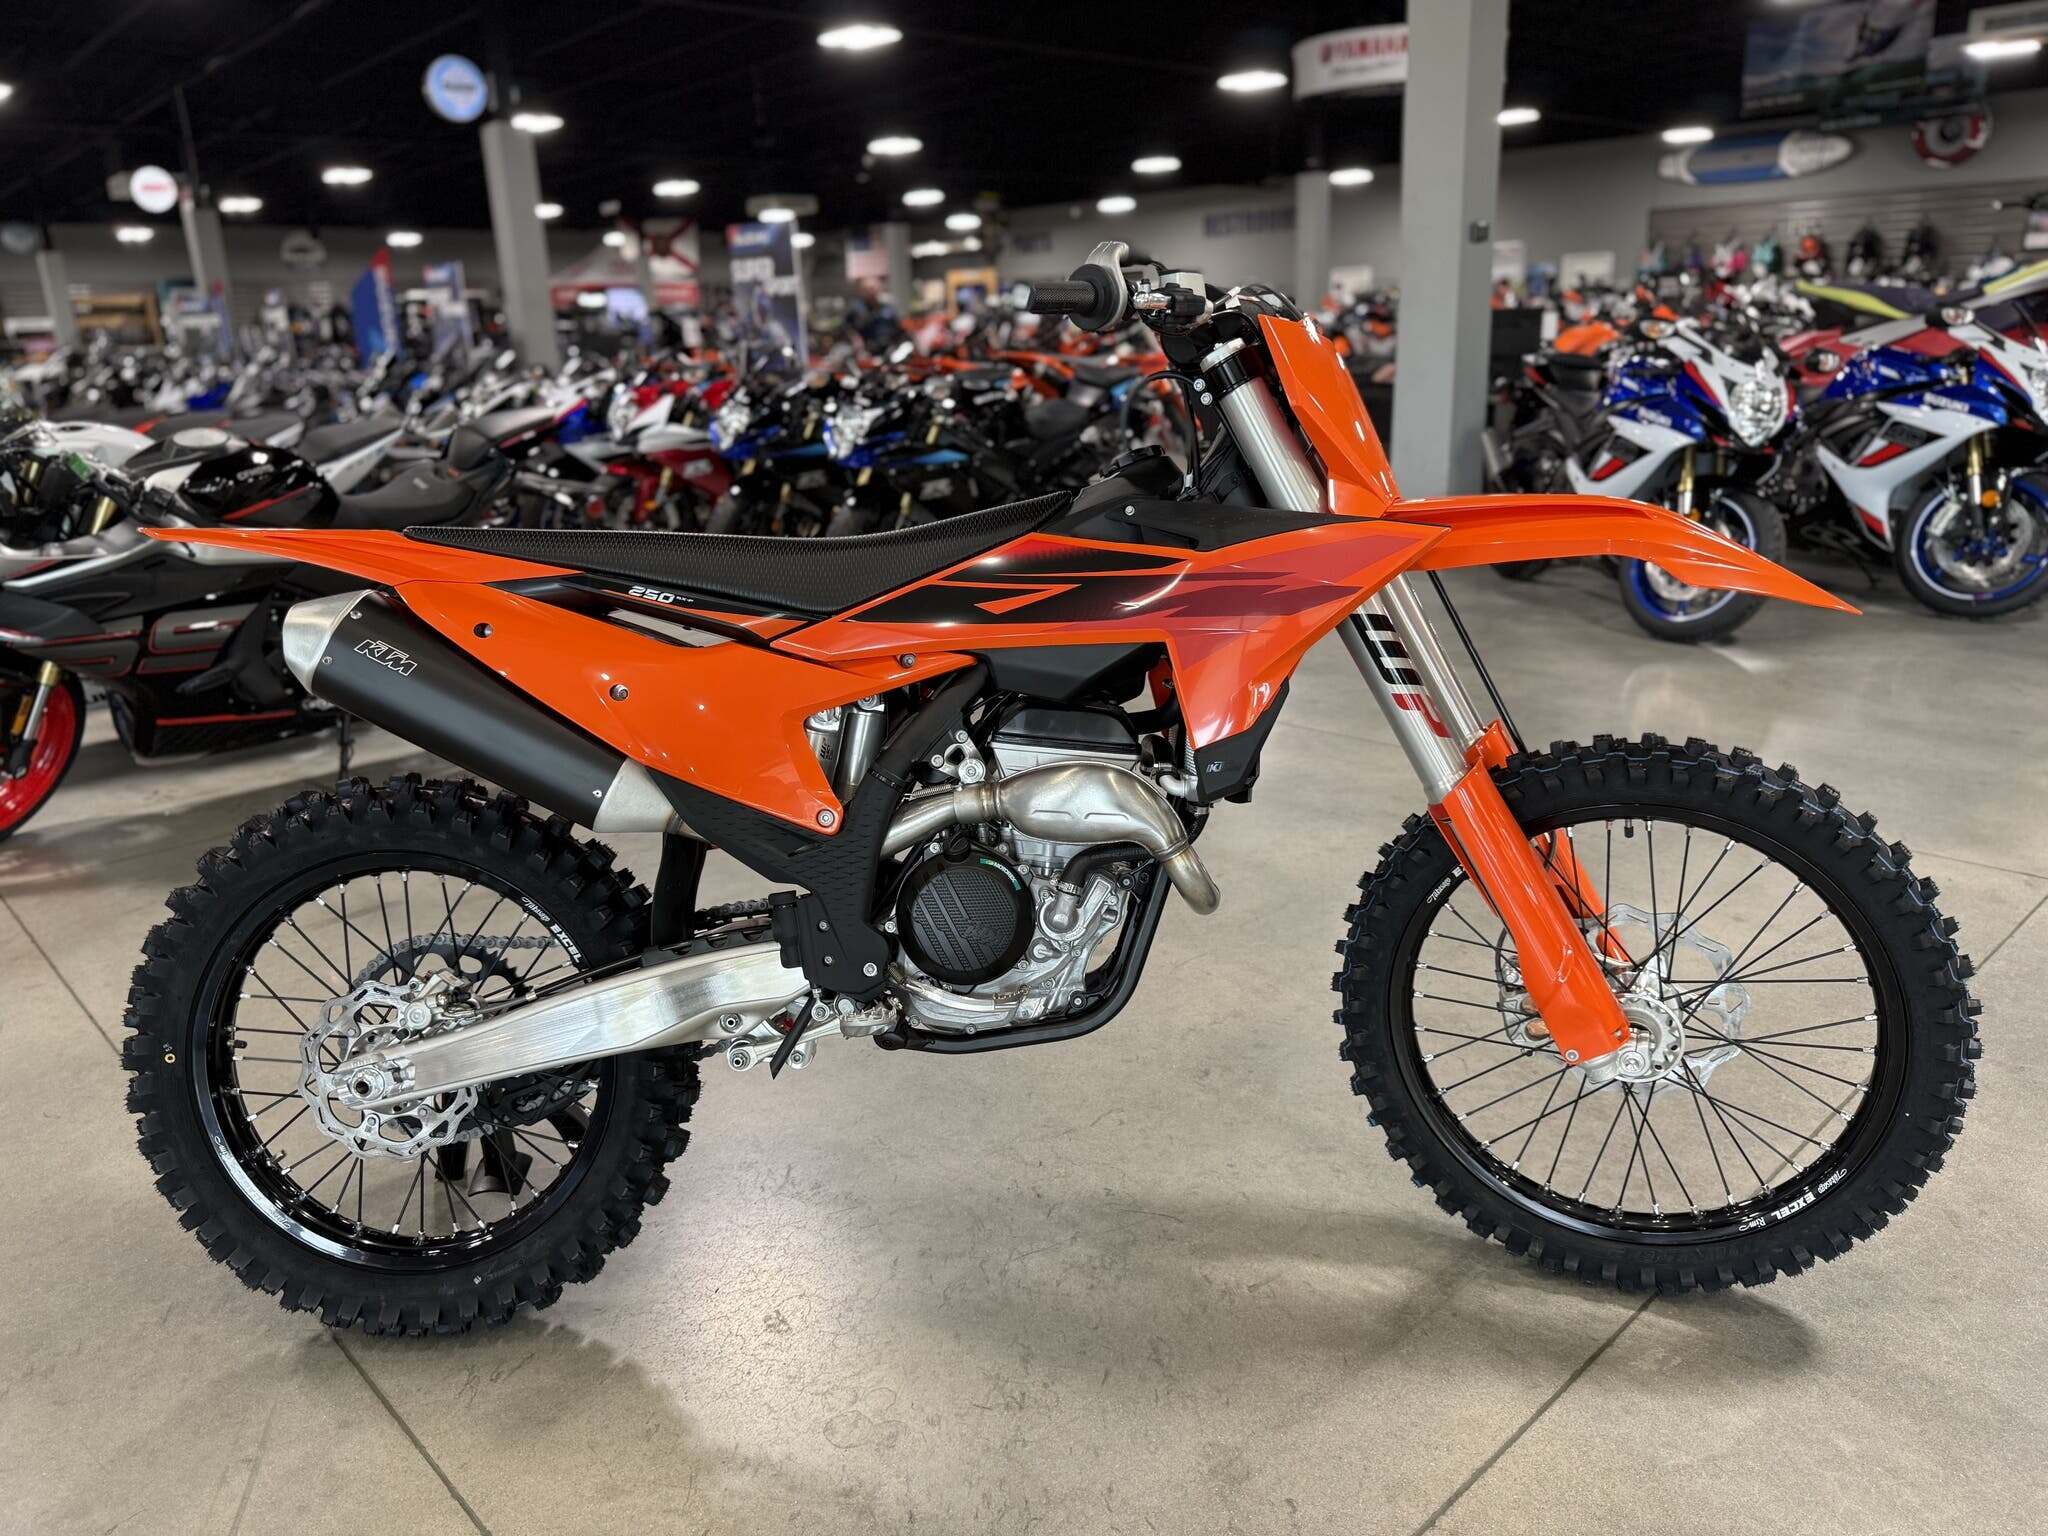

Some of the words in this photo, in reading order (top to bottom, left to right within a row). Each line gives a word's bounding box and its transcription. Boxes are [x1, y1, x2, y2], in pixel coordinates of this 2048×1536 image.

[628, 585, 676, 604] 250
[353, 639, 418, 676] KTM
[1347, 613, 1455, 739] WP
[550, 923, 582, 963] EXCEL
[1770, 1191, 1817, 1220] EXCEL
